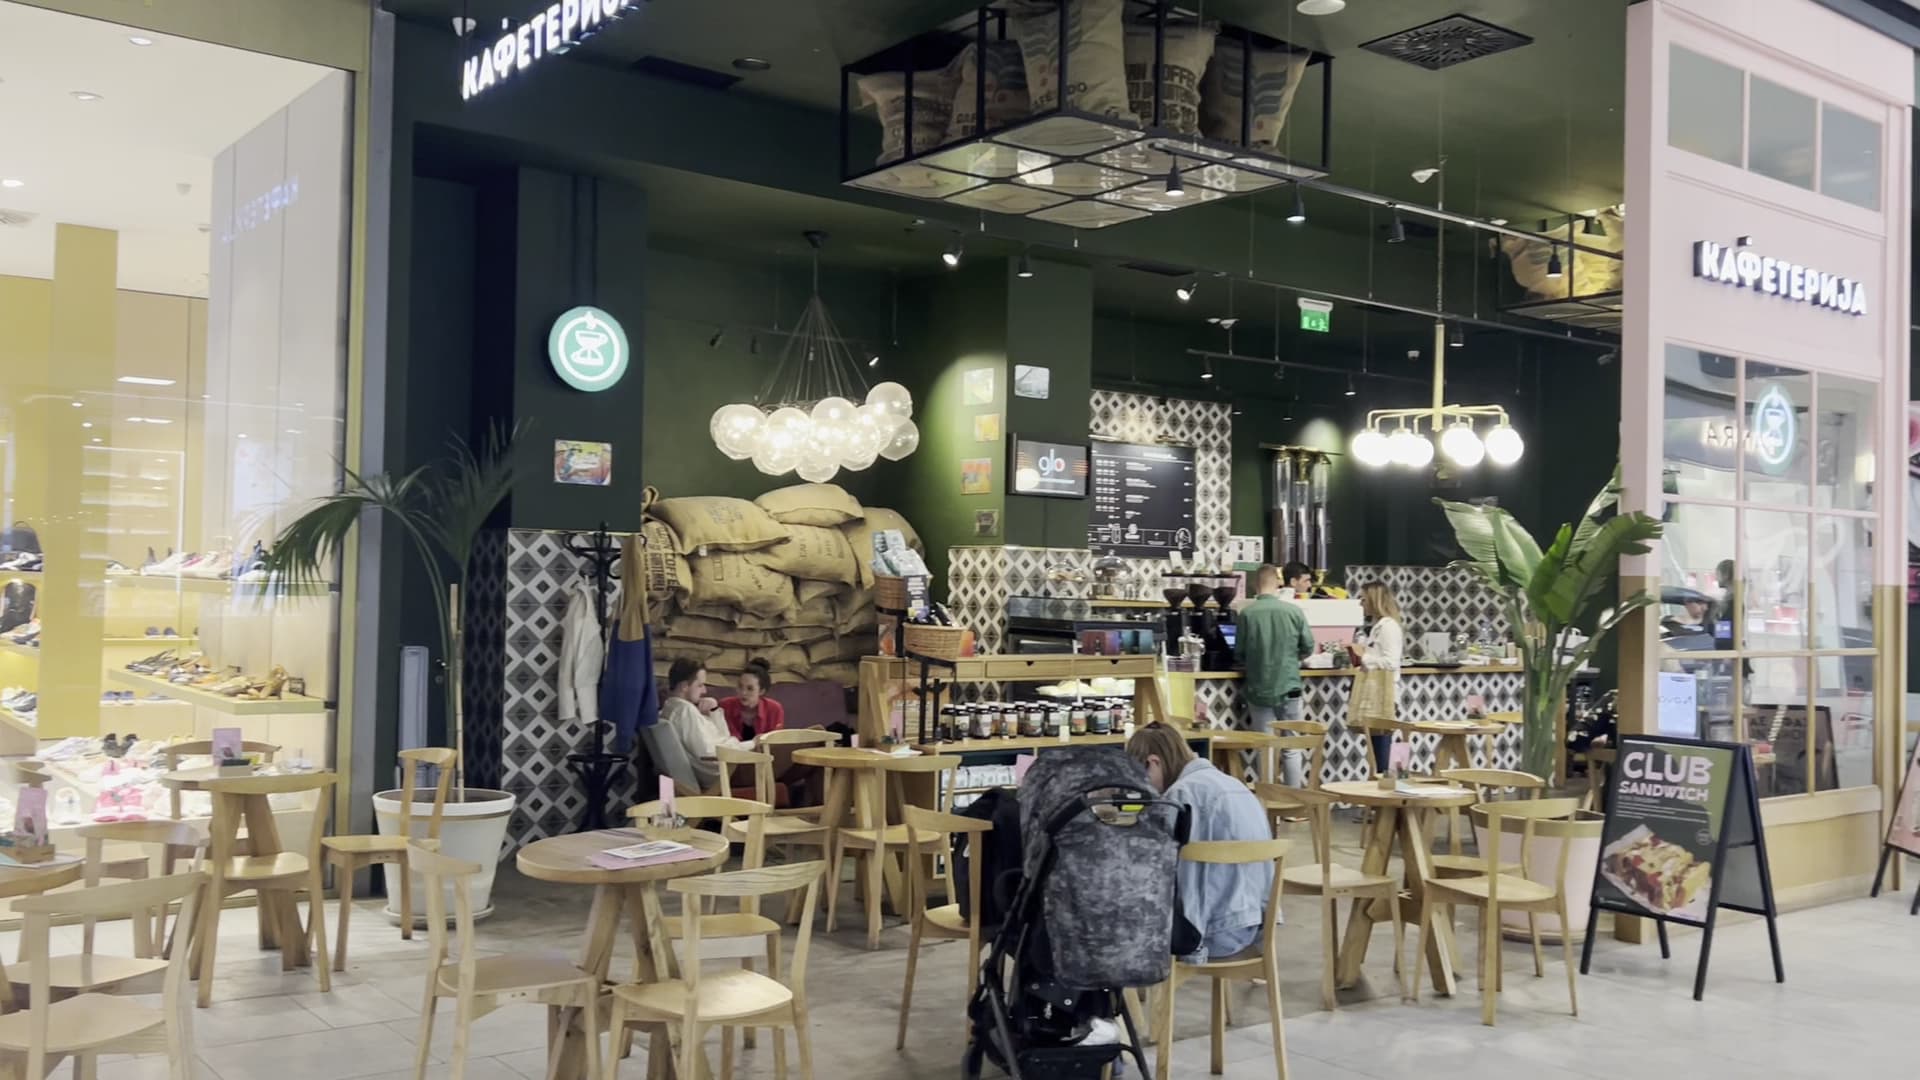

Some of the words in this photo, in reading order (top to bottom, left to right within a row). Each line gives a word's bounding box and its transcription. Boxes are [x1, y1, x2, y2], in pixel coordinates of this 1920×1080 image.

[462, 0, 629, 100] КАФЕТЕРИ
[1699, 237, 1867, 315] КАФЕТЕРИЈА
[1618, 781, 1709, 801] SANDWICH
[1623, 752, 1714, 785] CLUB
